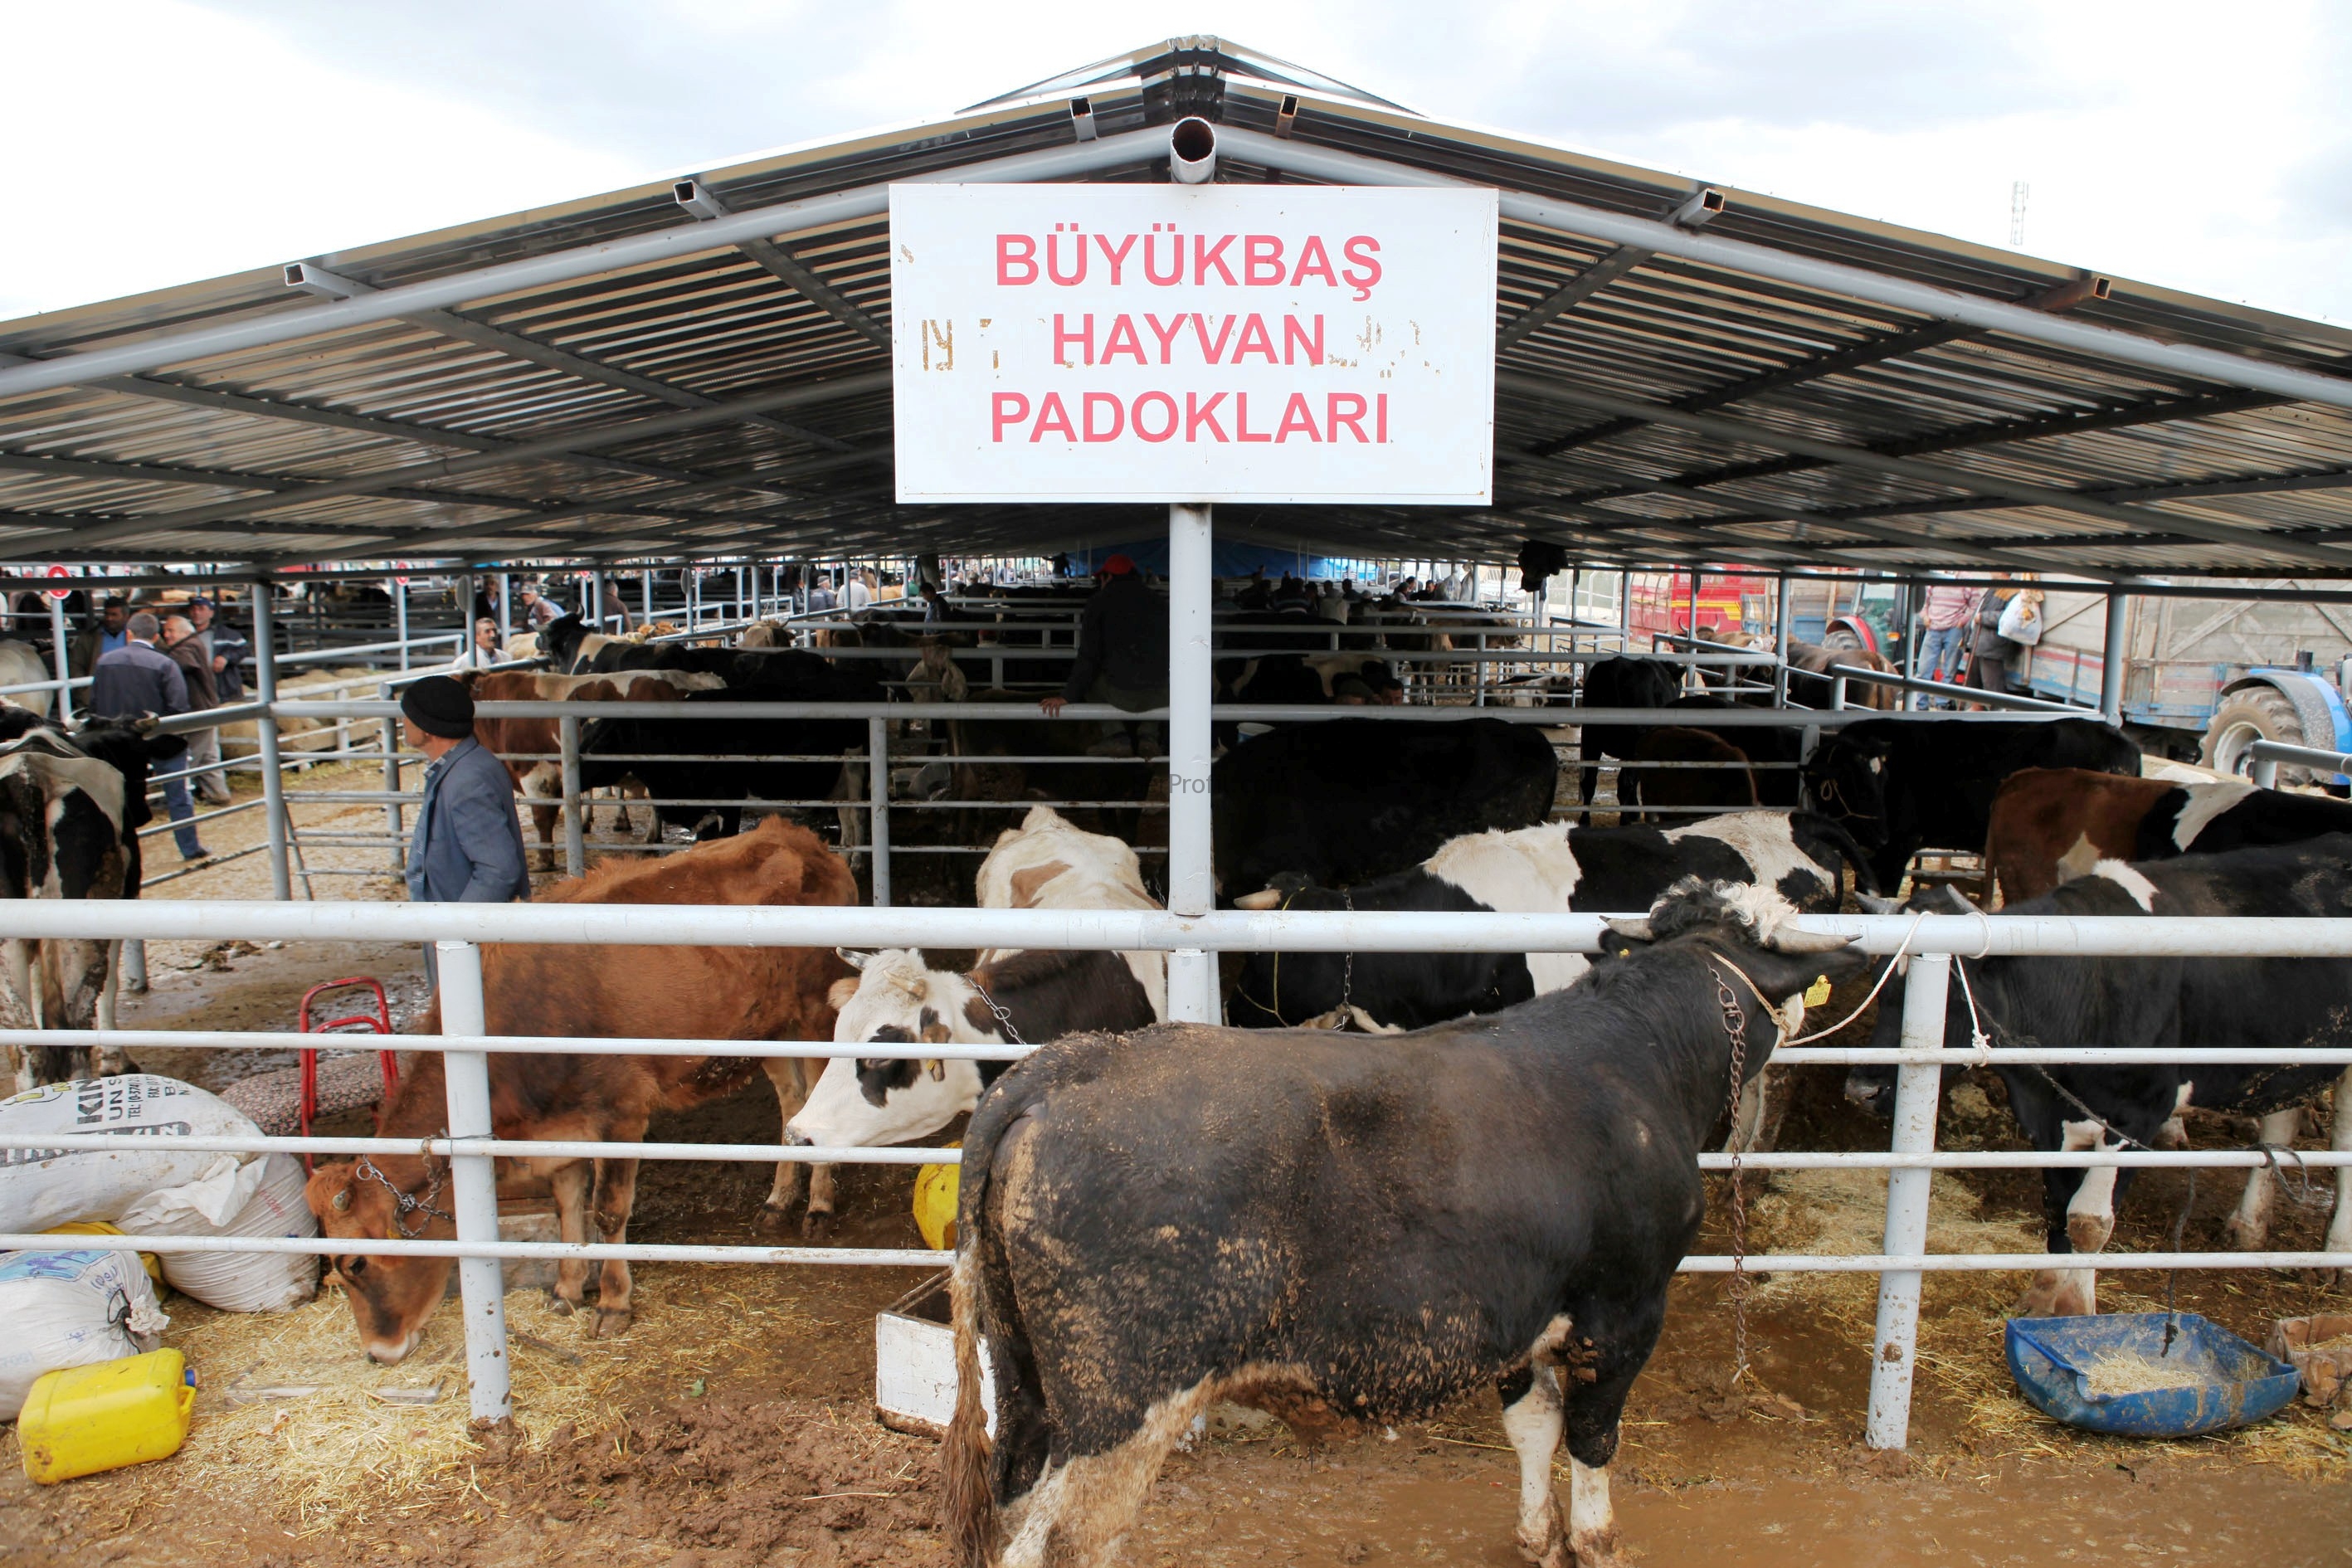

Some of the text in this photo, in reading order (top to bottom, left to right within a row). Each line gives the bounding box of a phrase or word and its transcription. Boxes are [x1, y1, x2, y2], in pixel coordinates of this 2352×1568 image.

[996, 222, 1383, 302] BÜYÜKBAŞ
[1053, 313, 1325, 366] HAYVAN
[991, 391, 1389, 444] PADOKLARI
